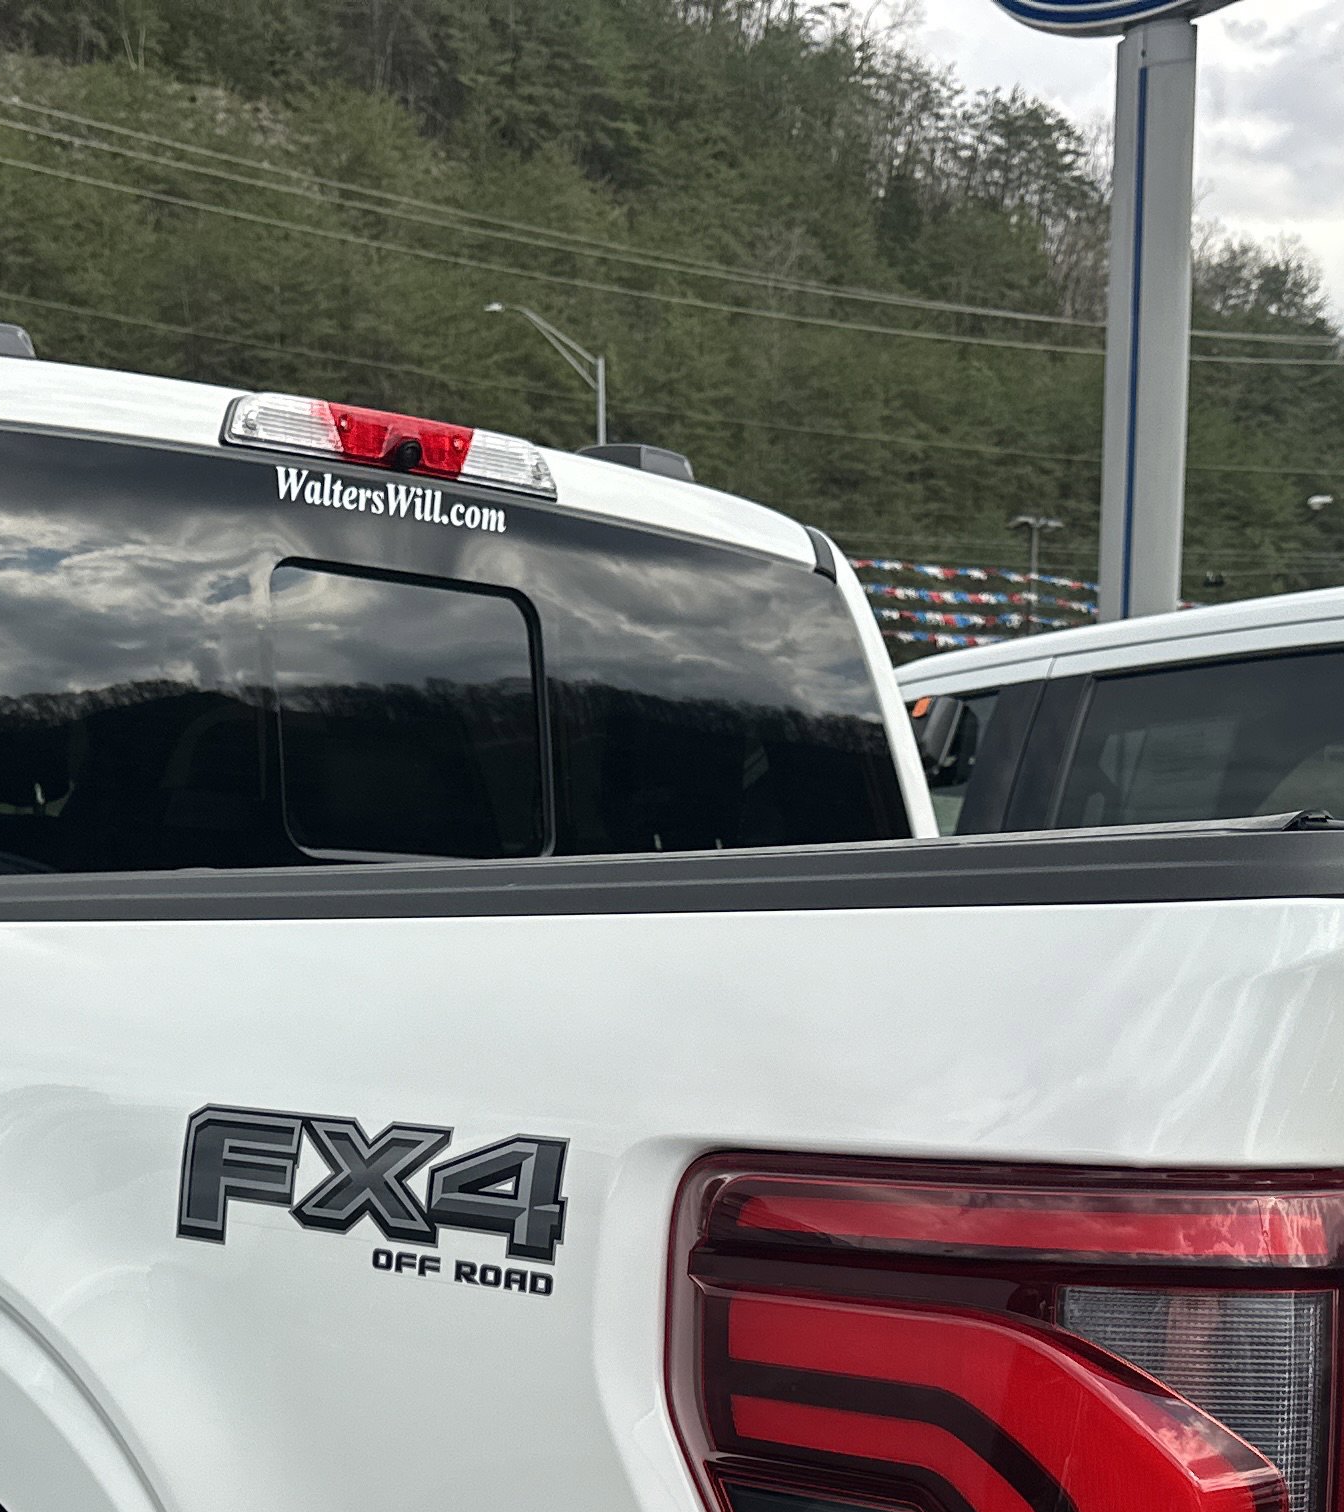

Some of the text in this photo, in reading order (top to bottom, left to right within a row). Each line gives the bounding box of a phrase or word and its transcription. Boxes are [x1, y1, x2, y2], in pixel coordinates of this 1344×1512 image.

[275, 466, 507, 533] WaltersWill.com
[175, 1102, 571, 1265] FX4
[371, 1247, 554, 1297] OFF ROAD
